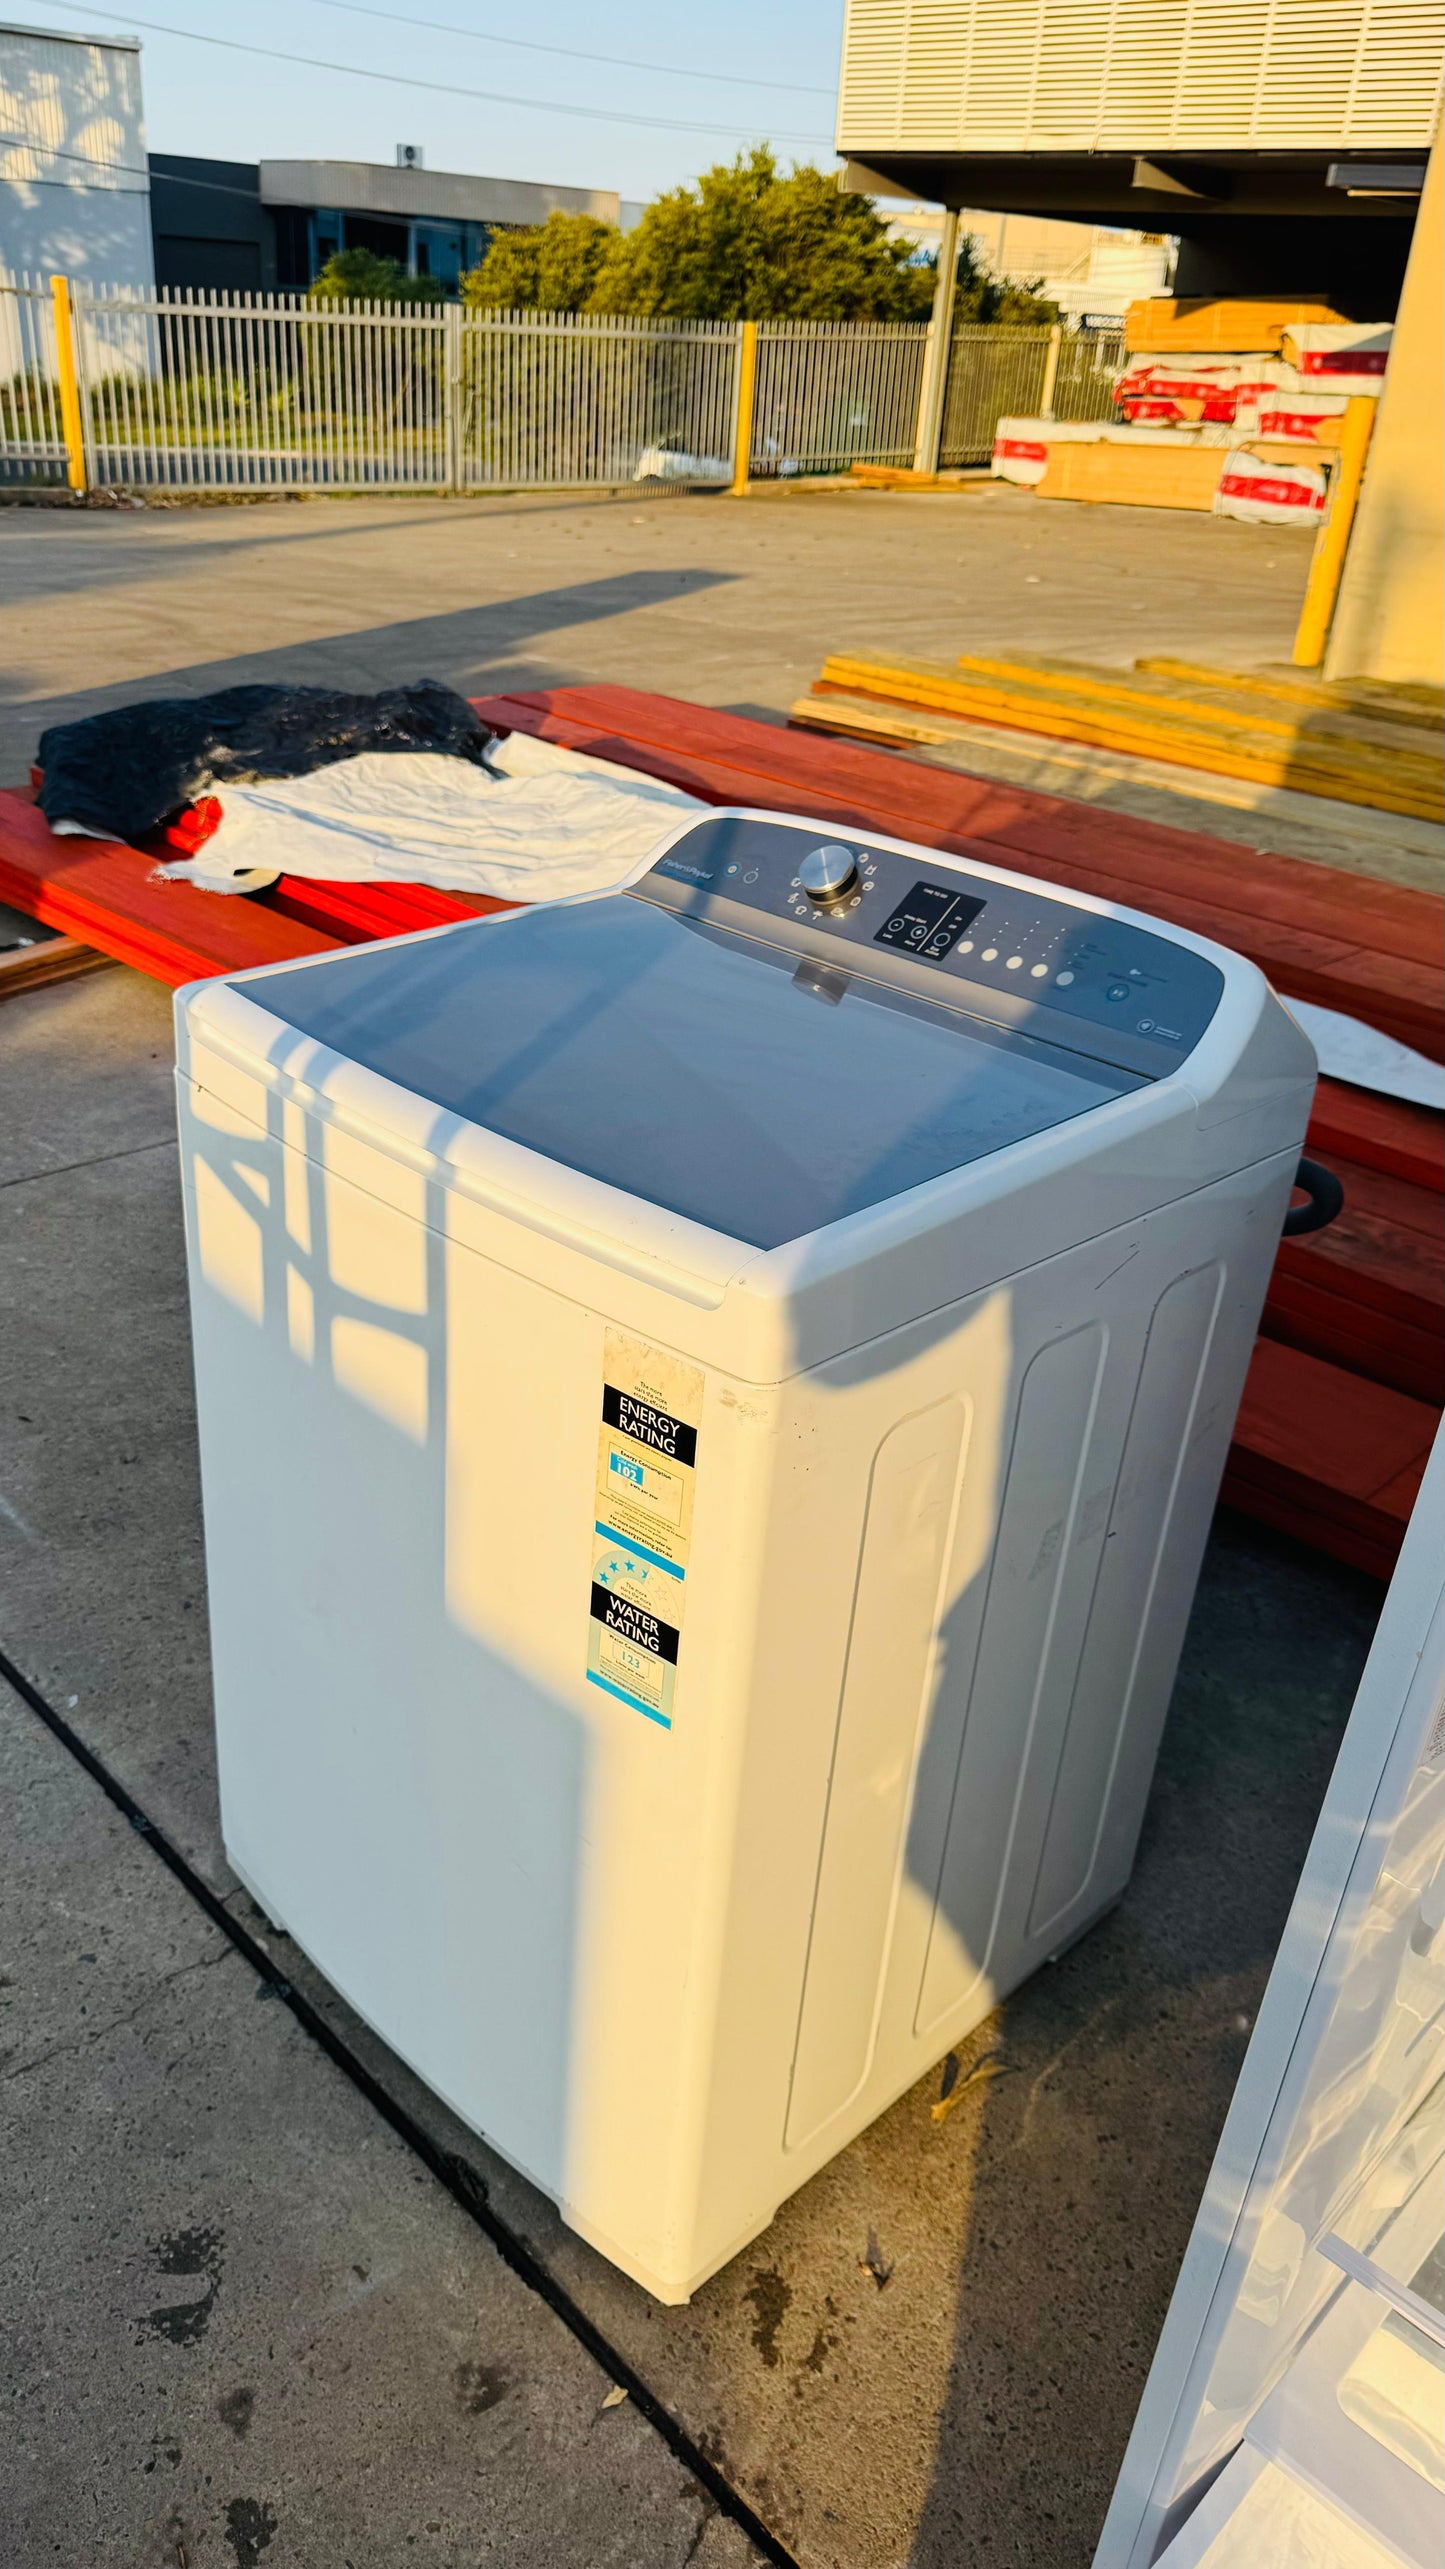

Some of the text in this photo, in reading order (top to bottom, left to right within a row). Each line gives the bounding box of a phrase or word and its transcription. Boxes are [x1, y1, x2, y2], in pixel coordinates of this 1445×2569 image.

[619, 1413, 676, 1454] RATING
[620, 1396, 680, 1437] ENERGY
[617, 1462, 637, 1482] 102
[620, 1450, 672, 1480] Energy Consumption
[606, 1609, 660, 1652] RATING
[609, 1595, 660, 1637] WATER
[622, 1651, 640, 1669] 123
